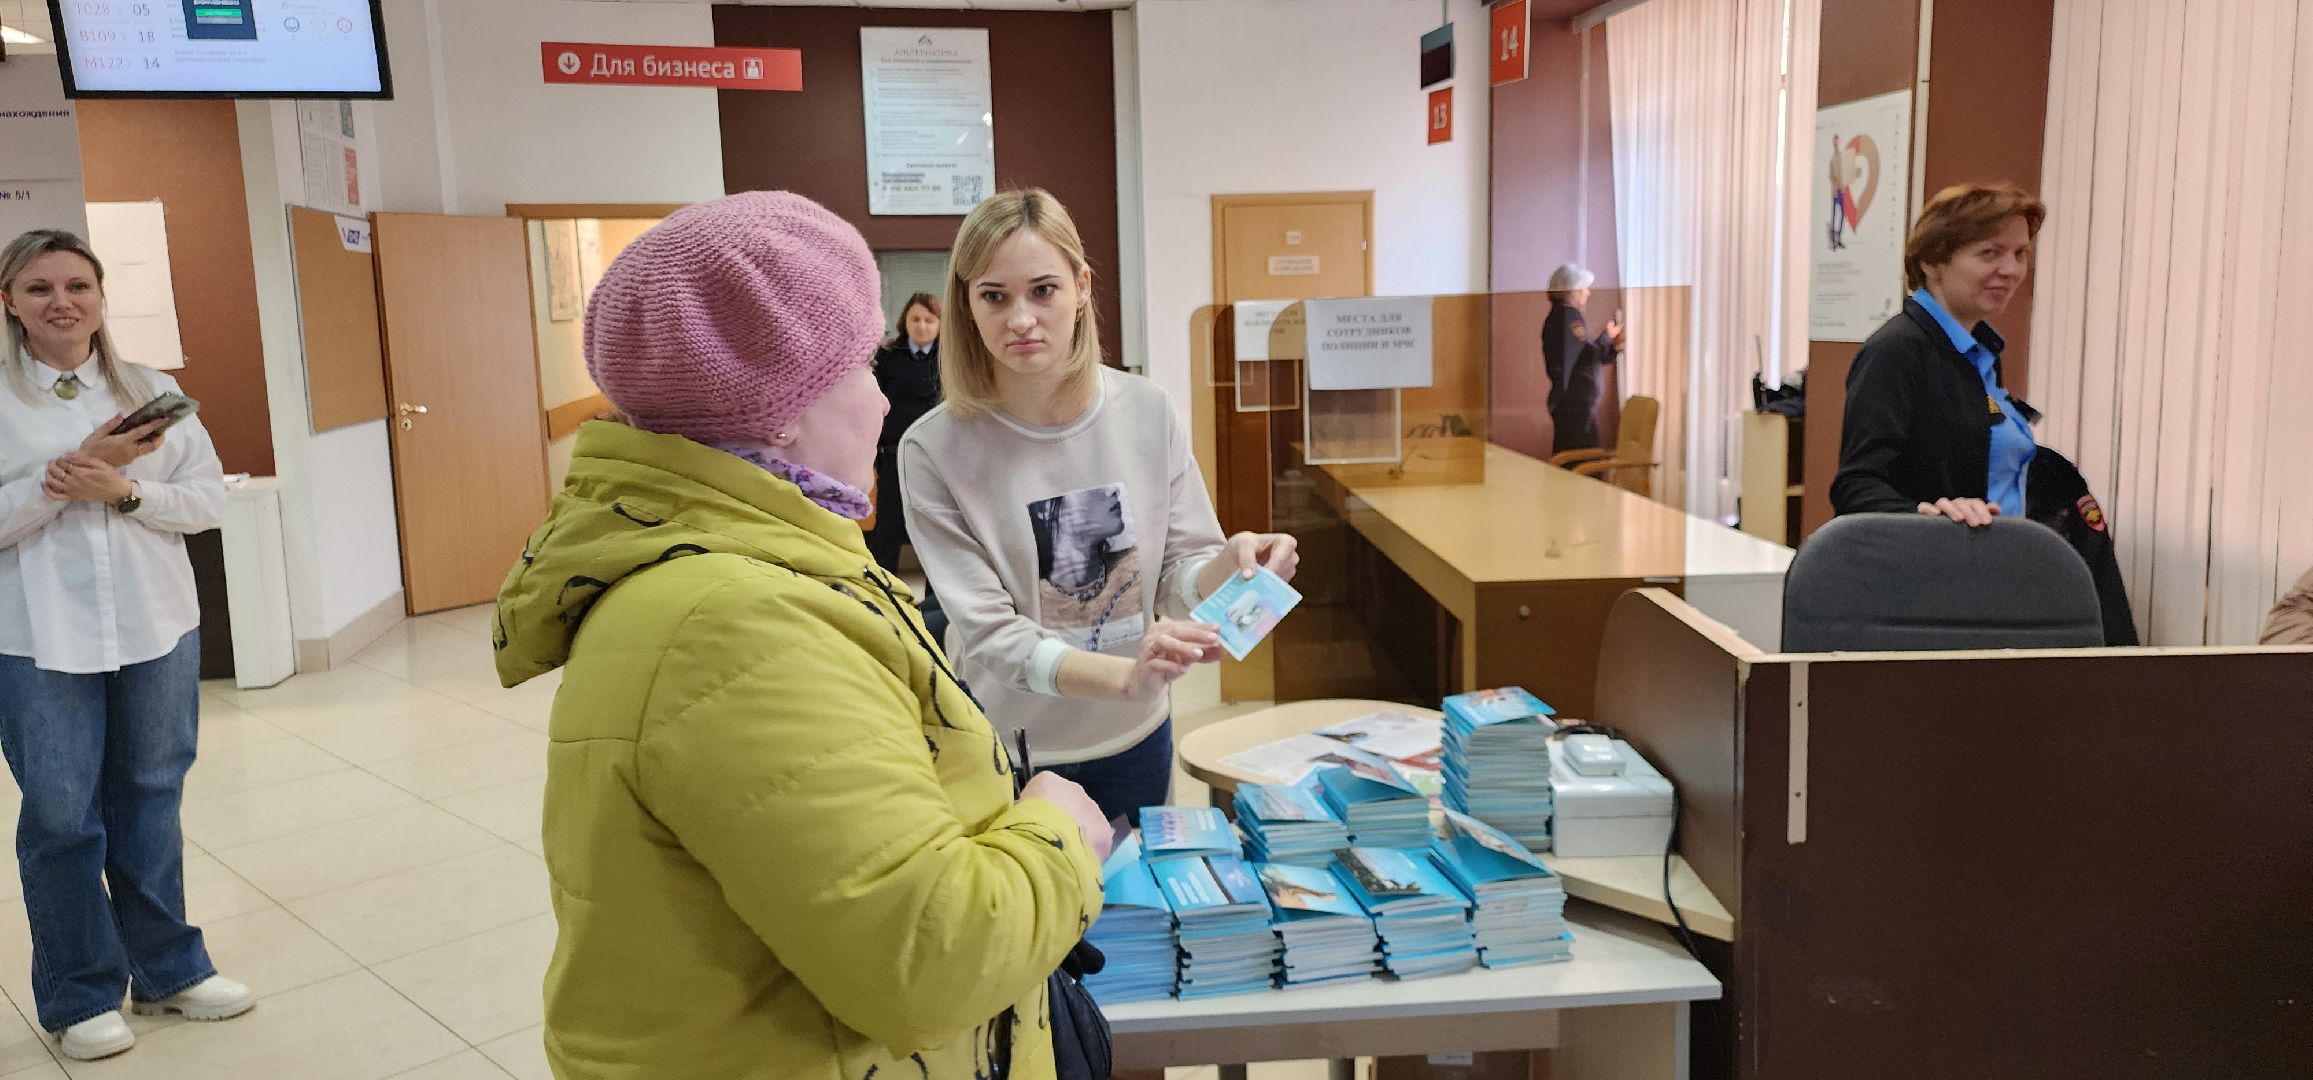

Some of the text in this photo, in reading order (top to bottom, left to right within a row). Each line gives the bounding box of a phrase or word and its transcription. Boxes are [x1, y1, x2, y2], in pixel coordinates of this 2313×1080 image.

[132, 3, 150, 17] 05
[138, 30, 155, 44] 18
[1501, 24, 1519, 61] 14
[143, 56, 160, 70] 14
[590, 52, 736, 79] Для бизнеса
[1433, 102, 1448, 130] 13
[1336, 312, 1402, 324] МЕСТА ДЛЯ
[1327, 326, 1412, 338] СОТРУДНИКОВ
[1321, 340, 1378, 351] ПОЛИЦИИ
